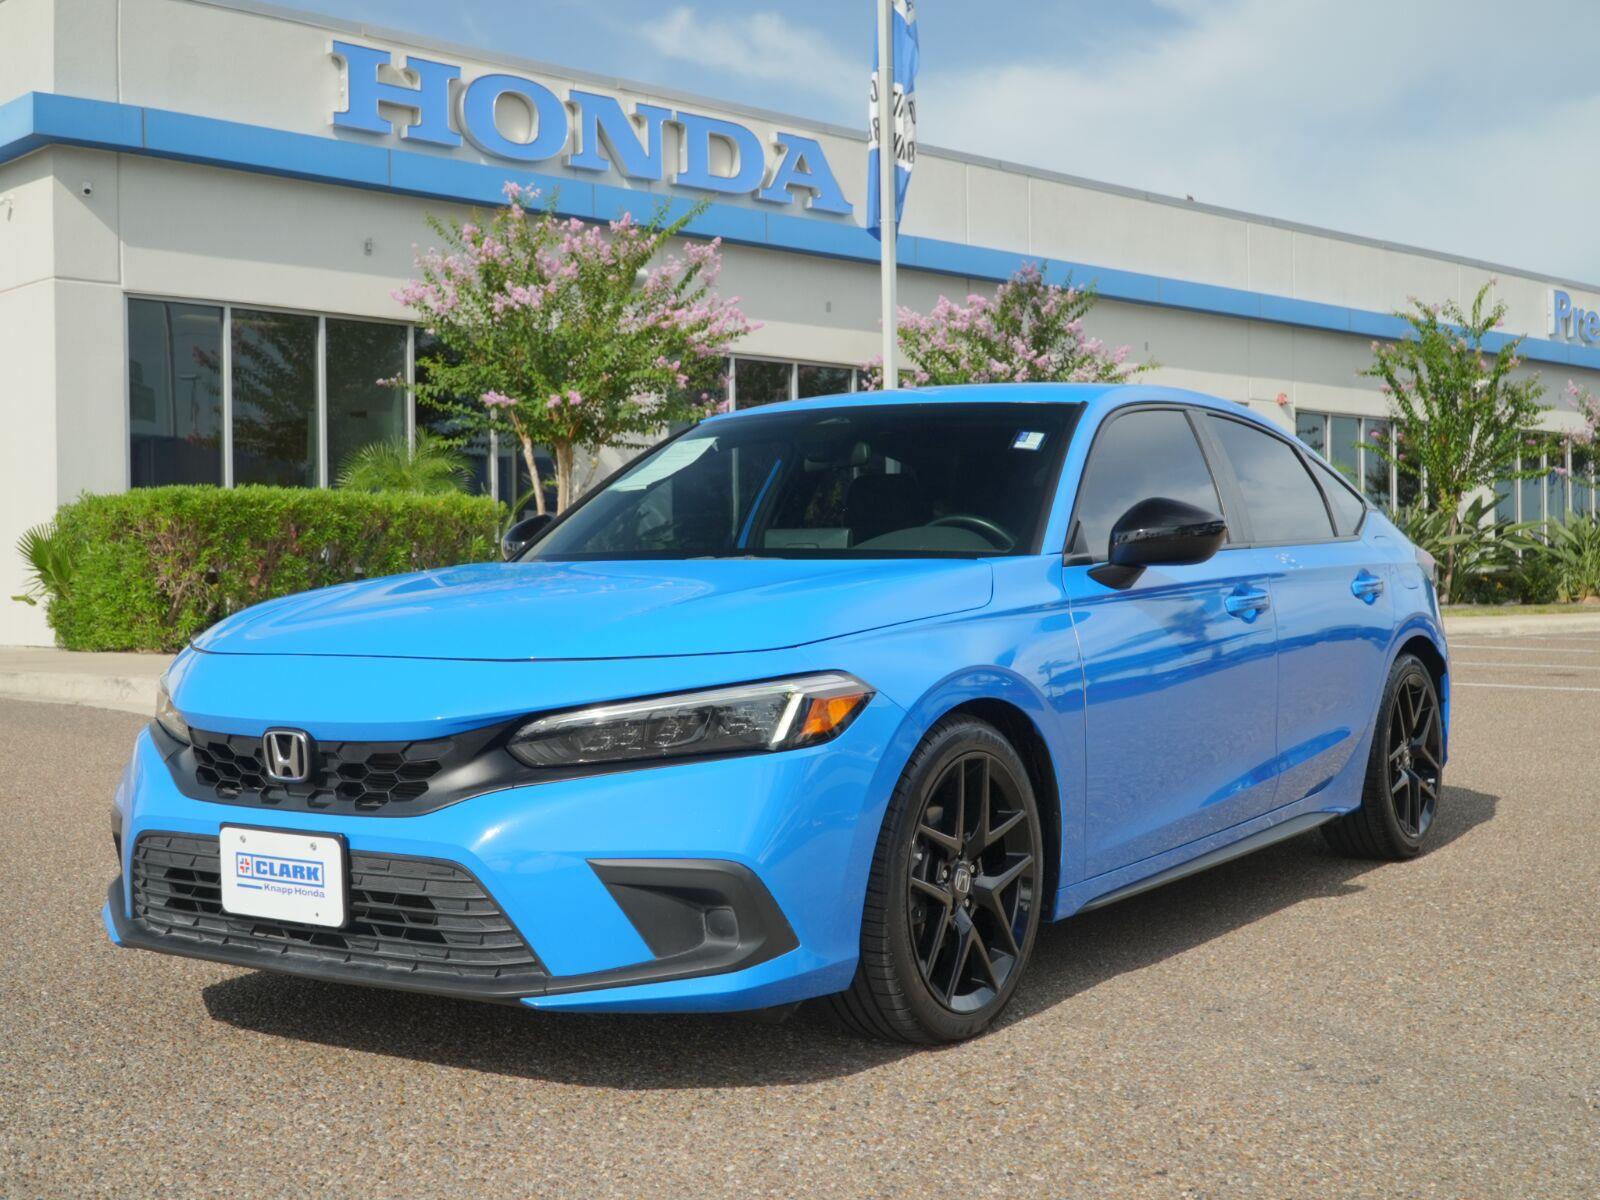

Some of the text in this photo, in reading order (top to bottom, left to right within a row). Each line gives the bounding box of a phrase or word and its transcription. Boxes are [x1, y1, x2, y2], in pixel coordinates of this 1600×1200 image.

[332, 39, 853, 216] HONDA
[255, 860, 321, 881] CLARK
[263, 883, 326, 898] Knapp Honda
